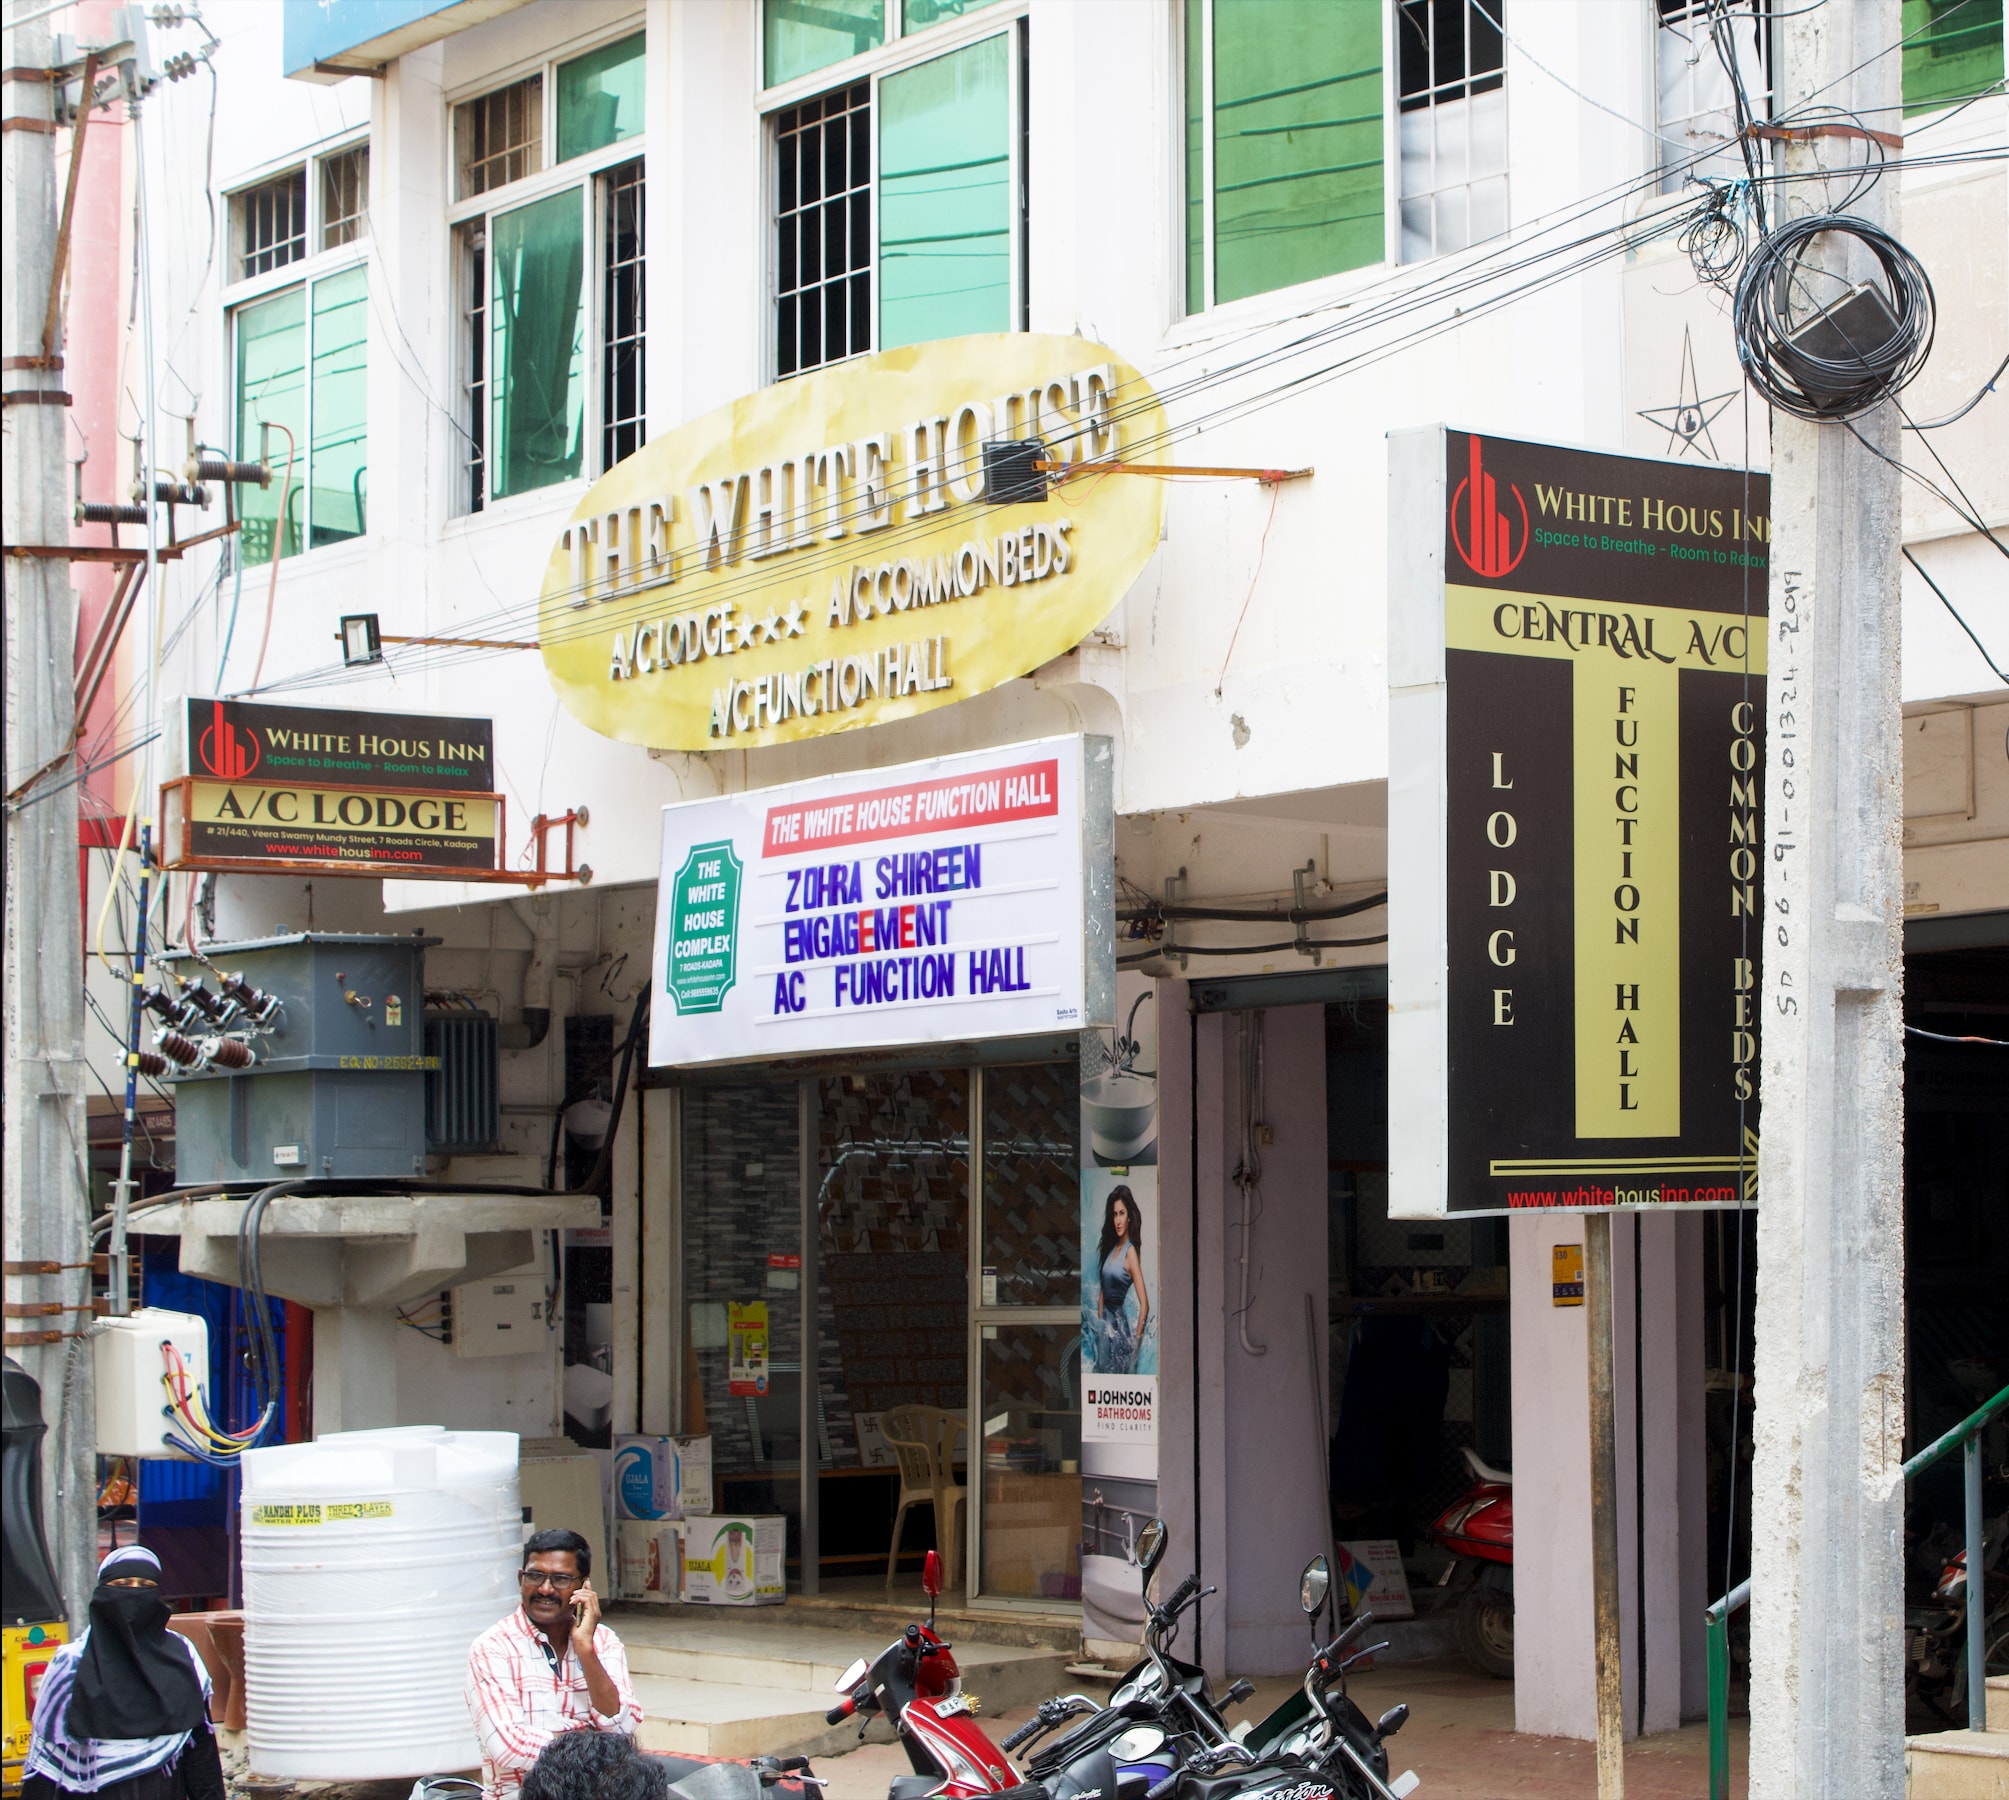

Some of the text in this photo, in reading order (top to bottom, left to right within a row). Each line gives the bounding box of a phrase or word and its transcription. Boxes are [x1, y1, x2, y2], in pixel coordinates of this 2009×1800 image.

[561, 494, 676, 608] THE
[687, 433, 895, 572] WHITE
[1642, 497, 1723, 537] HOUS
[1535, 527, 1580, 549] Space
[1583, 533, 1598, 549] to
[1601, 536, 1655, 556] Breathe
[1670, 543, 1710, 562] Room
[1713, 548, 1727, 563] to
[1730, 550, 1766, 569] Relax
[657, 602, 739, 669] LODGE
[873, 543, 1002, 618] COMMON
[999, 519, 1075, 588] BEDS
[1493, 601, 1748, 666] CENTRAL A/C
[751, 649, 884, 725] FUNCTION
[878, 636, 953, 700] HALL
[266, 754, 305, 766] Space
[308, 757, 320, 767] to
[323, 758, 372, 771] Breathe
[384, 761, 419, 773] Room
[422, 763, 434, 774] to
[436, 764, 469, 777] Relax
[359, 734, 431, 759] HOUS
[439, 739, 485, 762] INN
[216, 788, 468, 831] A/C LODGE
[771, 772, 1051, 845] THE WHITE HOUSE FUNCTION HALL
[1612, 686, 1640, 946] FUNCTION
[1728, 701, 1758, 917] COMMON
[252, 830, 279, 840] Veera
[280, 832, 314, 843] Swamy
[316, 833, 347, 845] Mundy
[348, 835, 377, 846] Street,
[379, 837, 384, 845] 7
[386, 837, 412, 847] Roads
[415, 838, 442, 849] Circle,
[443, 840, 478, 851] Kadapa
[266, 843, 423, 861] www.whitehousinn.com
[698, 859, 721, 880] THE
[785, 843, 981, 913] ZOHRA SHIREEN
[1486, 752, 1518, 1026] LODGE
[688, 882, 726, 904] WHITE
[684, 909, 725, 932] HOUSE
[784, 901, 952, 963] ENGAGEMENT
[674, 934, 731, 958] COMPLEX
[774, 945, 1031, 1016] AC FUNCTION HALL
[1613, 983, 1640, 1111] HALL
[1732, 958, 1756, 1102] BEDS
[1507, 1184, 1735, 1209] www.whitehousinn.com
[1097, 1390, 1152, 1406] JOHNSON
[1097, 1407, 1152, 1421] BATHROOMS
[1097, 1422, 1152, 1432] FIND CLARITY
[263, 1504, 321, 1518] NANDHI PLUS
[328, 1501, 392, 1518] THREE 3 LAYER
